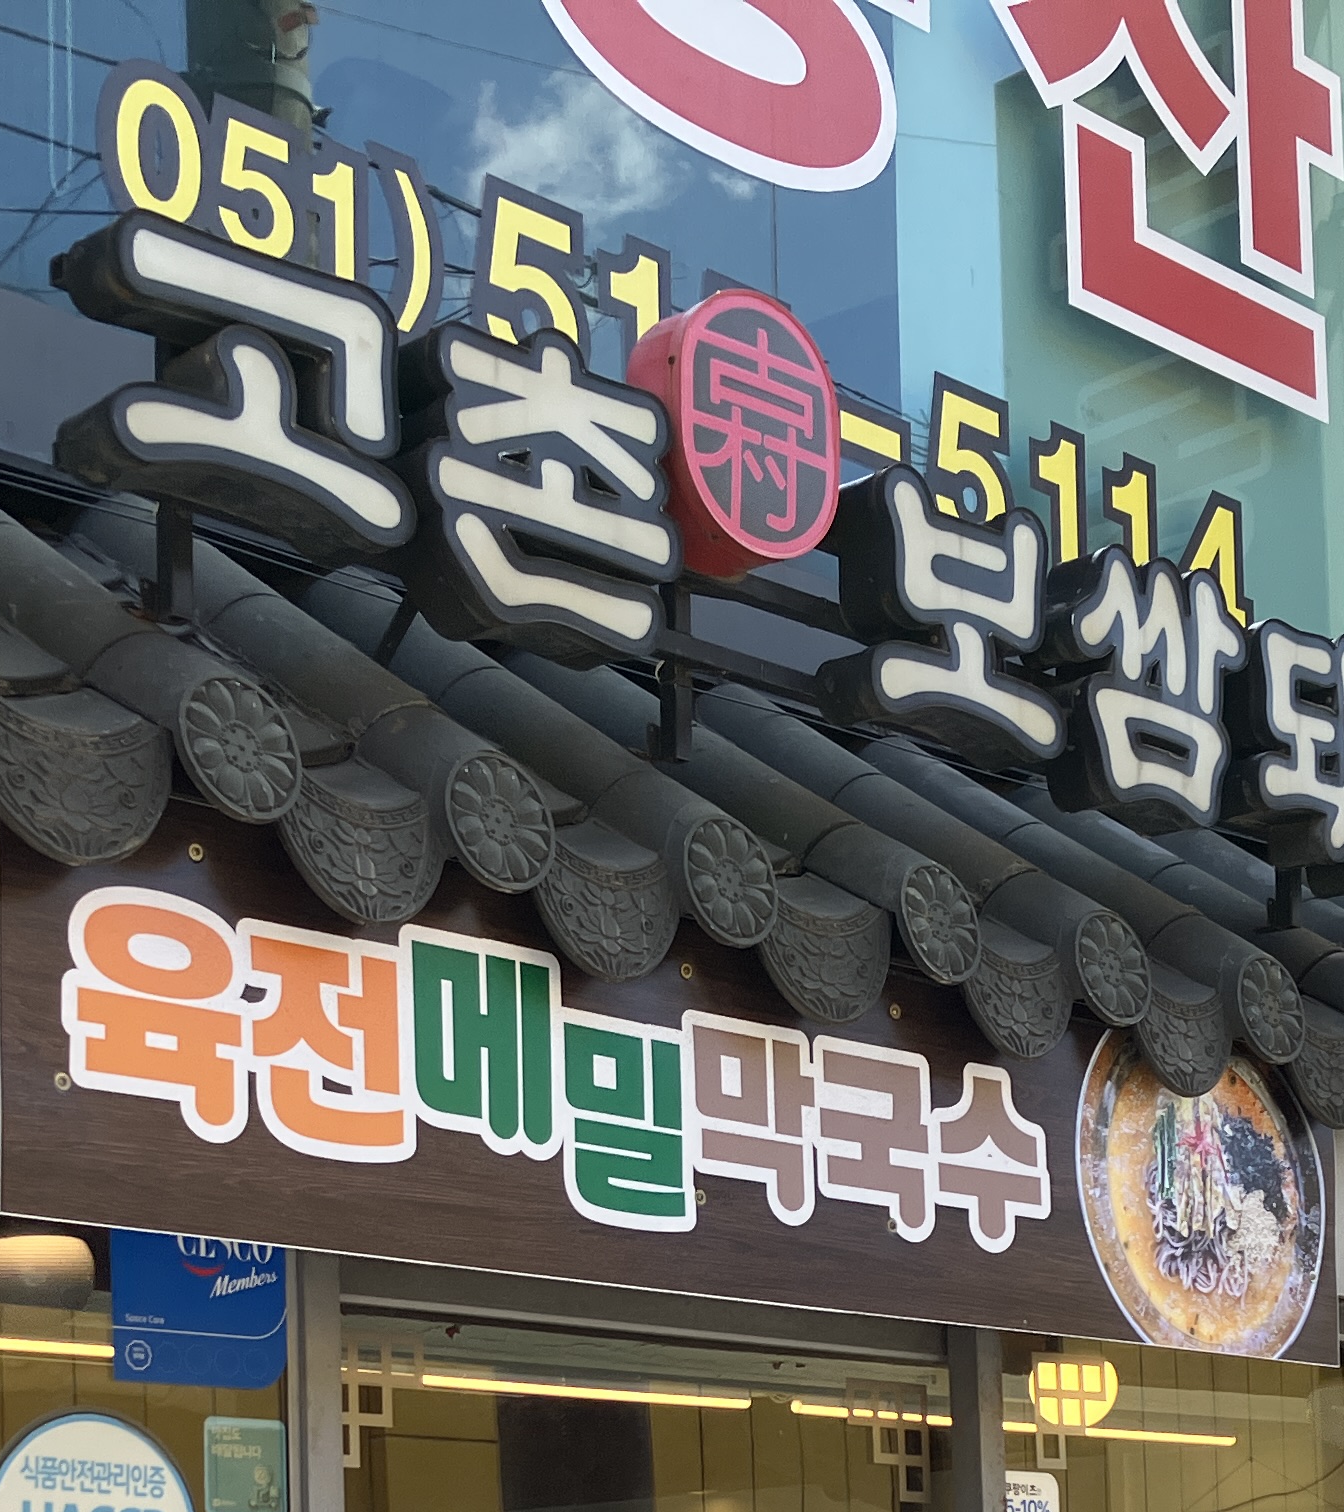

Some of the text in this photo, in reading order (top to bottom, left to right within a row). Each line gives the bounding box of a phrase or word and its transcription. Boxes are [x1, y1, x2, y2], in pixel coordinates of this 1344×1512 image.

[120, 220, 680, 652] 고촌
[210, 1266, 279, 1298] Members
[19, 1454, 167, 1500] 식품안전관리인증
